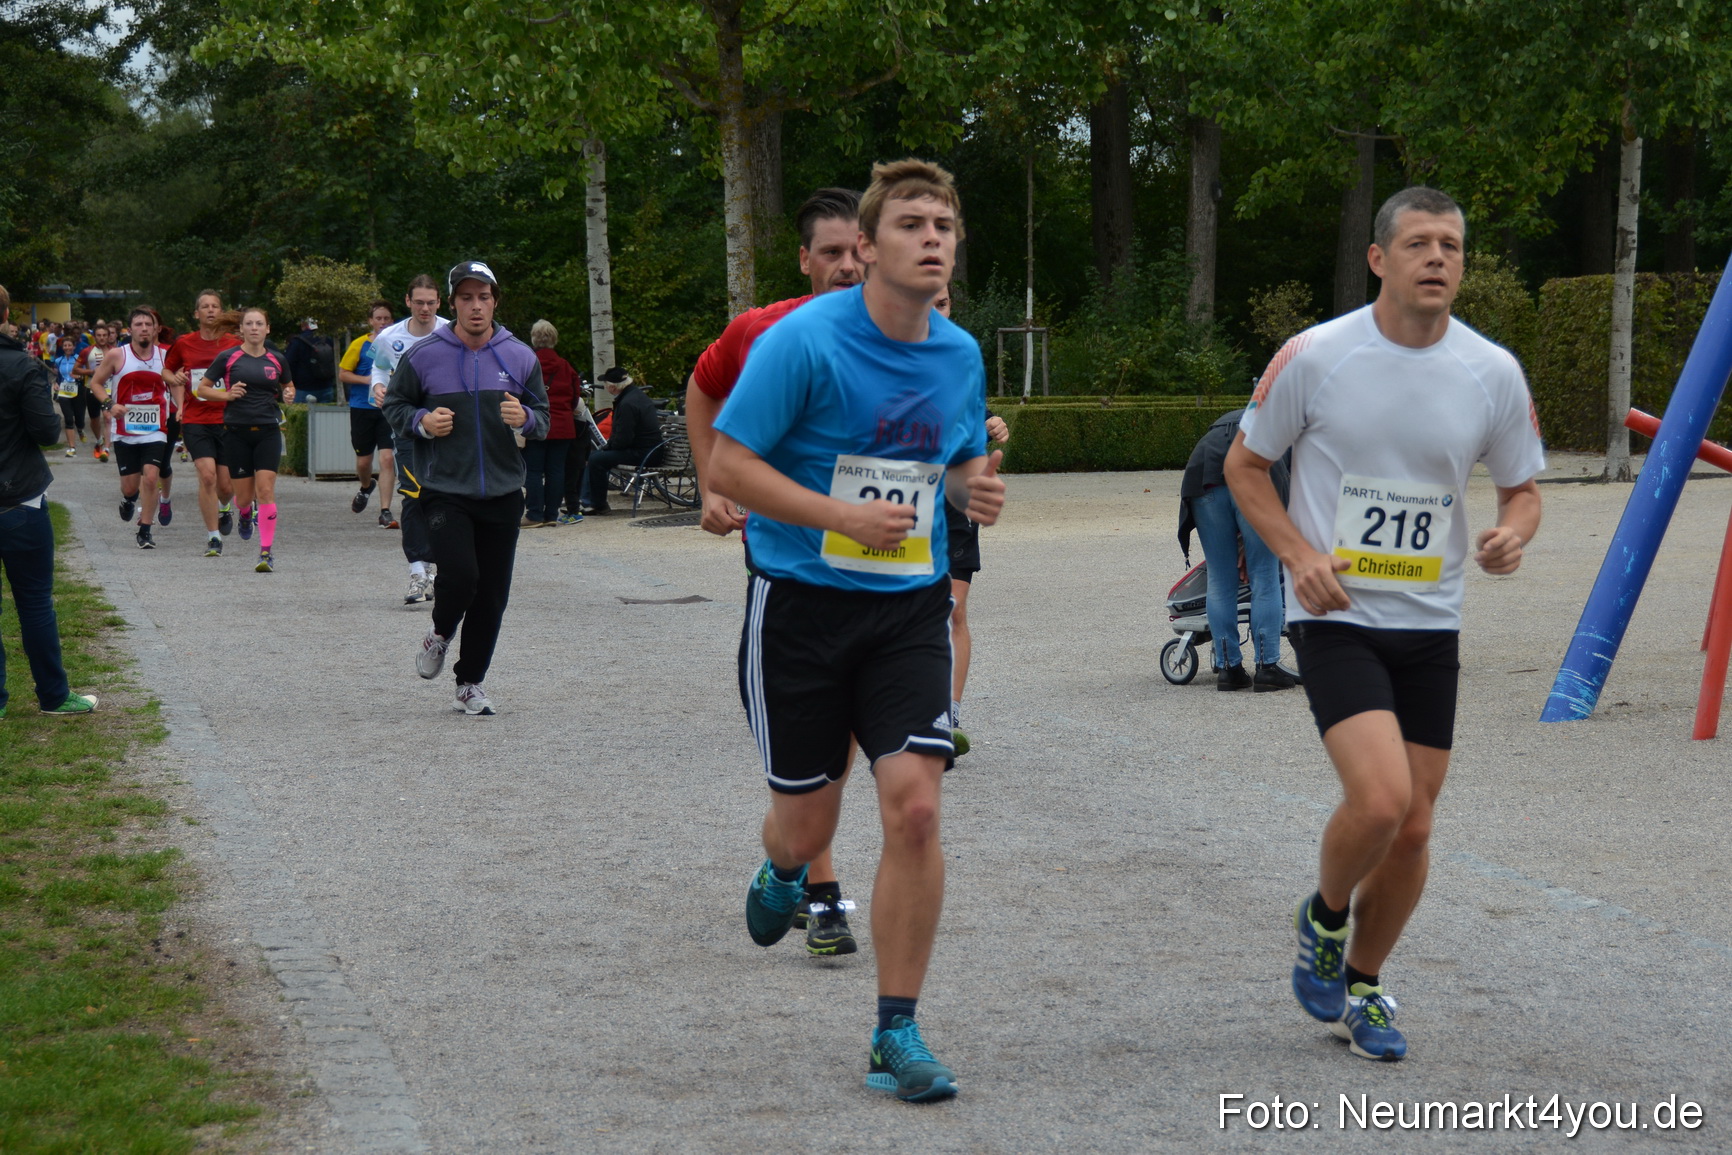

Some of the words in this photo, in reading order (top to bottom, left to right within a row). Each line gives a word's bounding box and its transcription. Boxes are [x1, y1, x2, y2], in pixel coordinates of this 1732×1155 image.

[128, 411, 157, 424] 2200
[875, 416, 940, 450] RUN
[837, 465, 879, 480] PARTL
[881, 471, 925, 483] Neumarkt
[1342, 486, 1384, 501] PARTL
[1386, 491, 1439, 506] Neumarkt
[1359, 506, 1432, 551] 218
[1357, 557, 1423, 577] Christian
